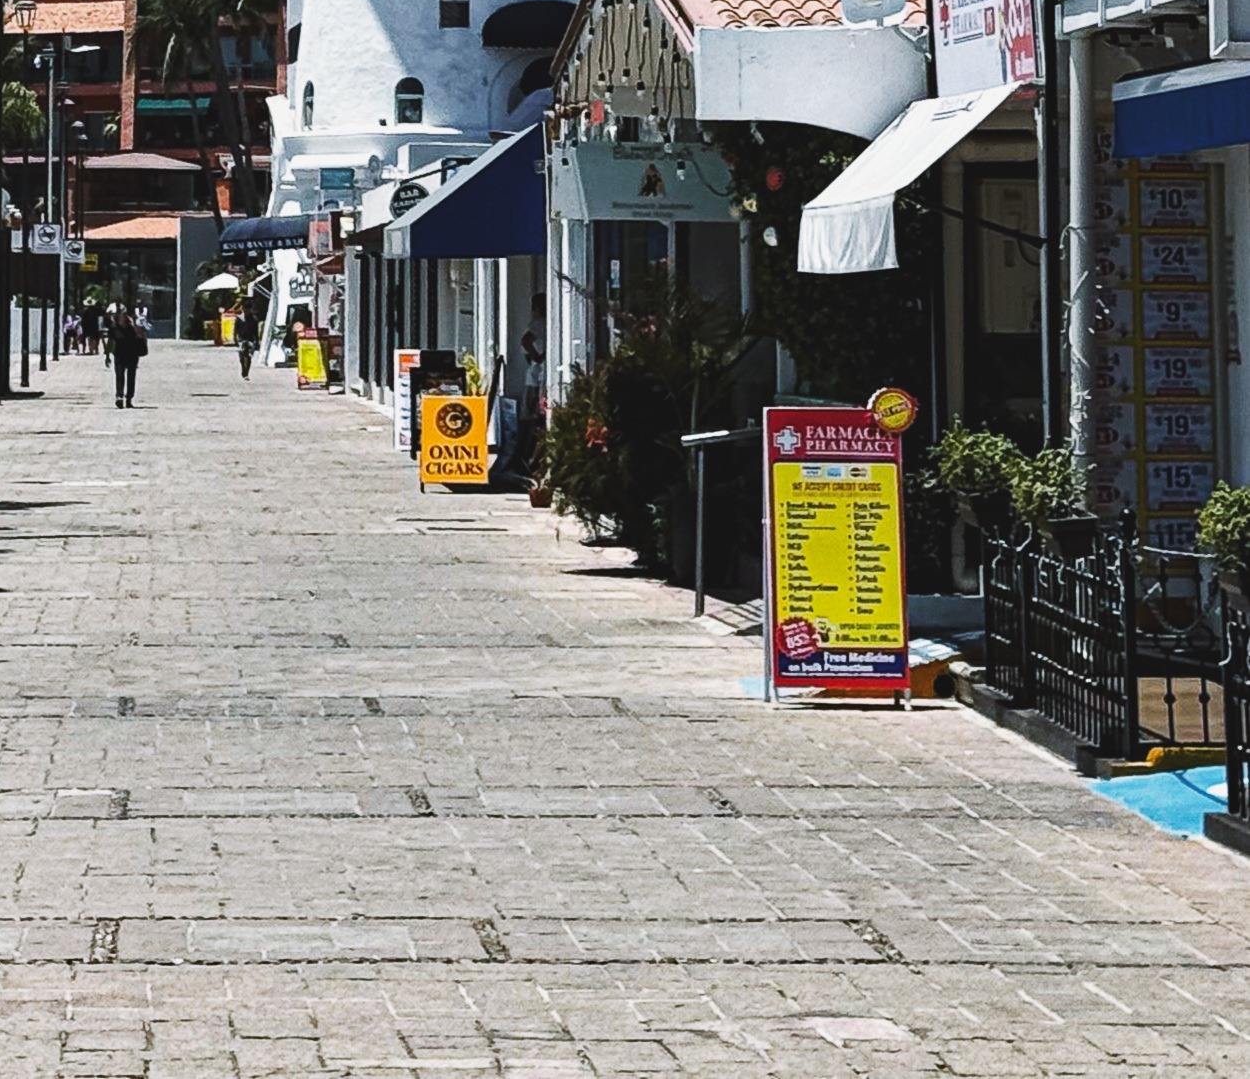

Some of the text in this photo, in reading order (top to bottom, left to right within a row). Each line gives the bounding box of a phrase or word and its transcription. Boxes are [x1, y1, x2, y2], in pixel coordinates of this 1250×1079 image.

[429, 445, 479, 460] OMNI
[805, 440, 895, 452] PHARMACY
[425, 461, 484, 476] CIGARS
